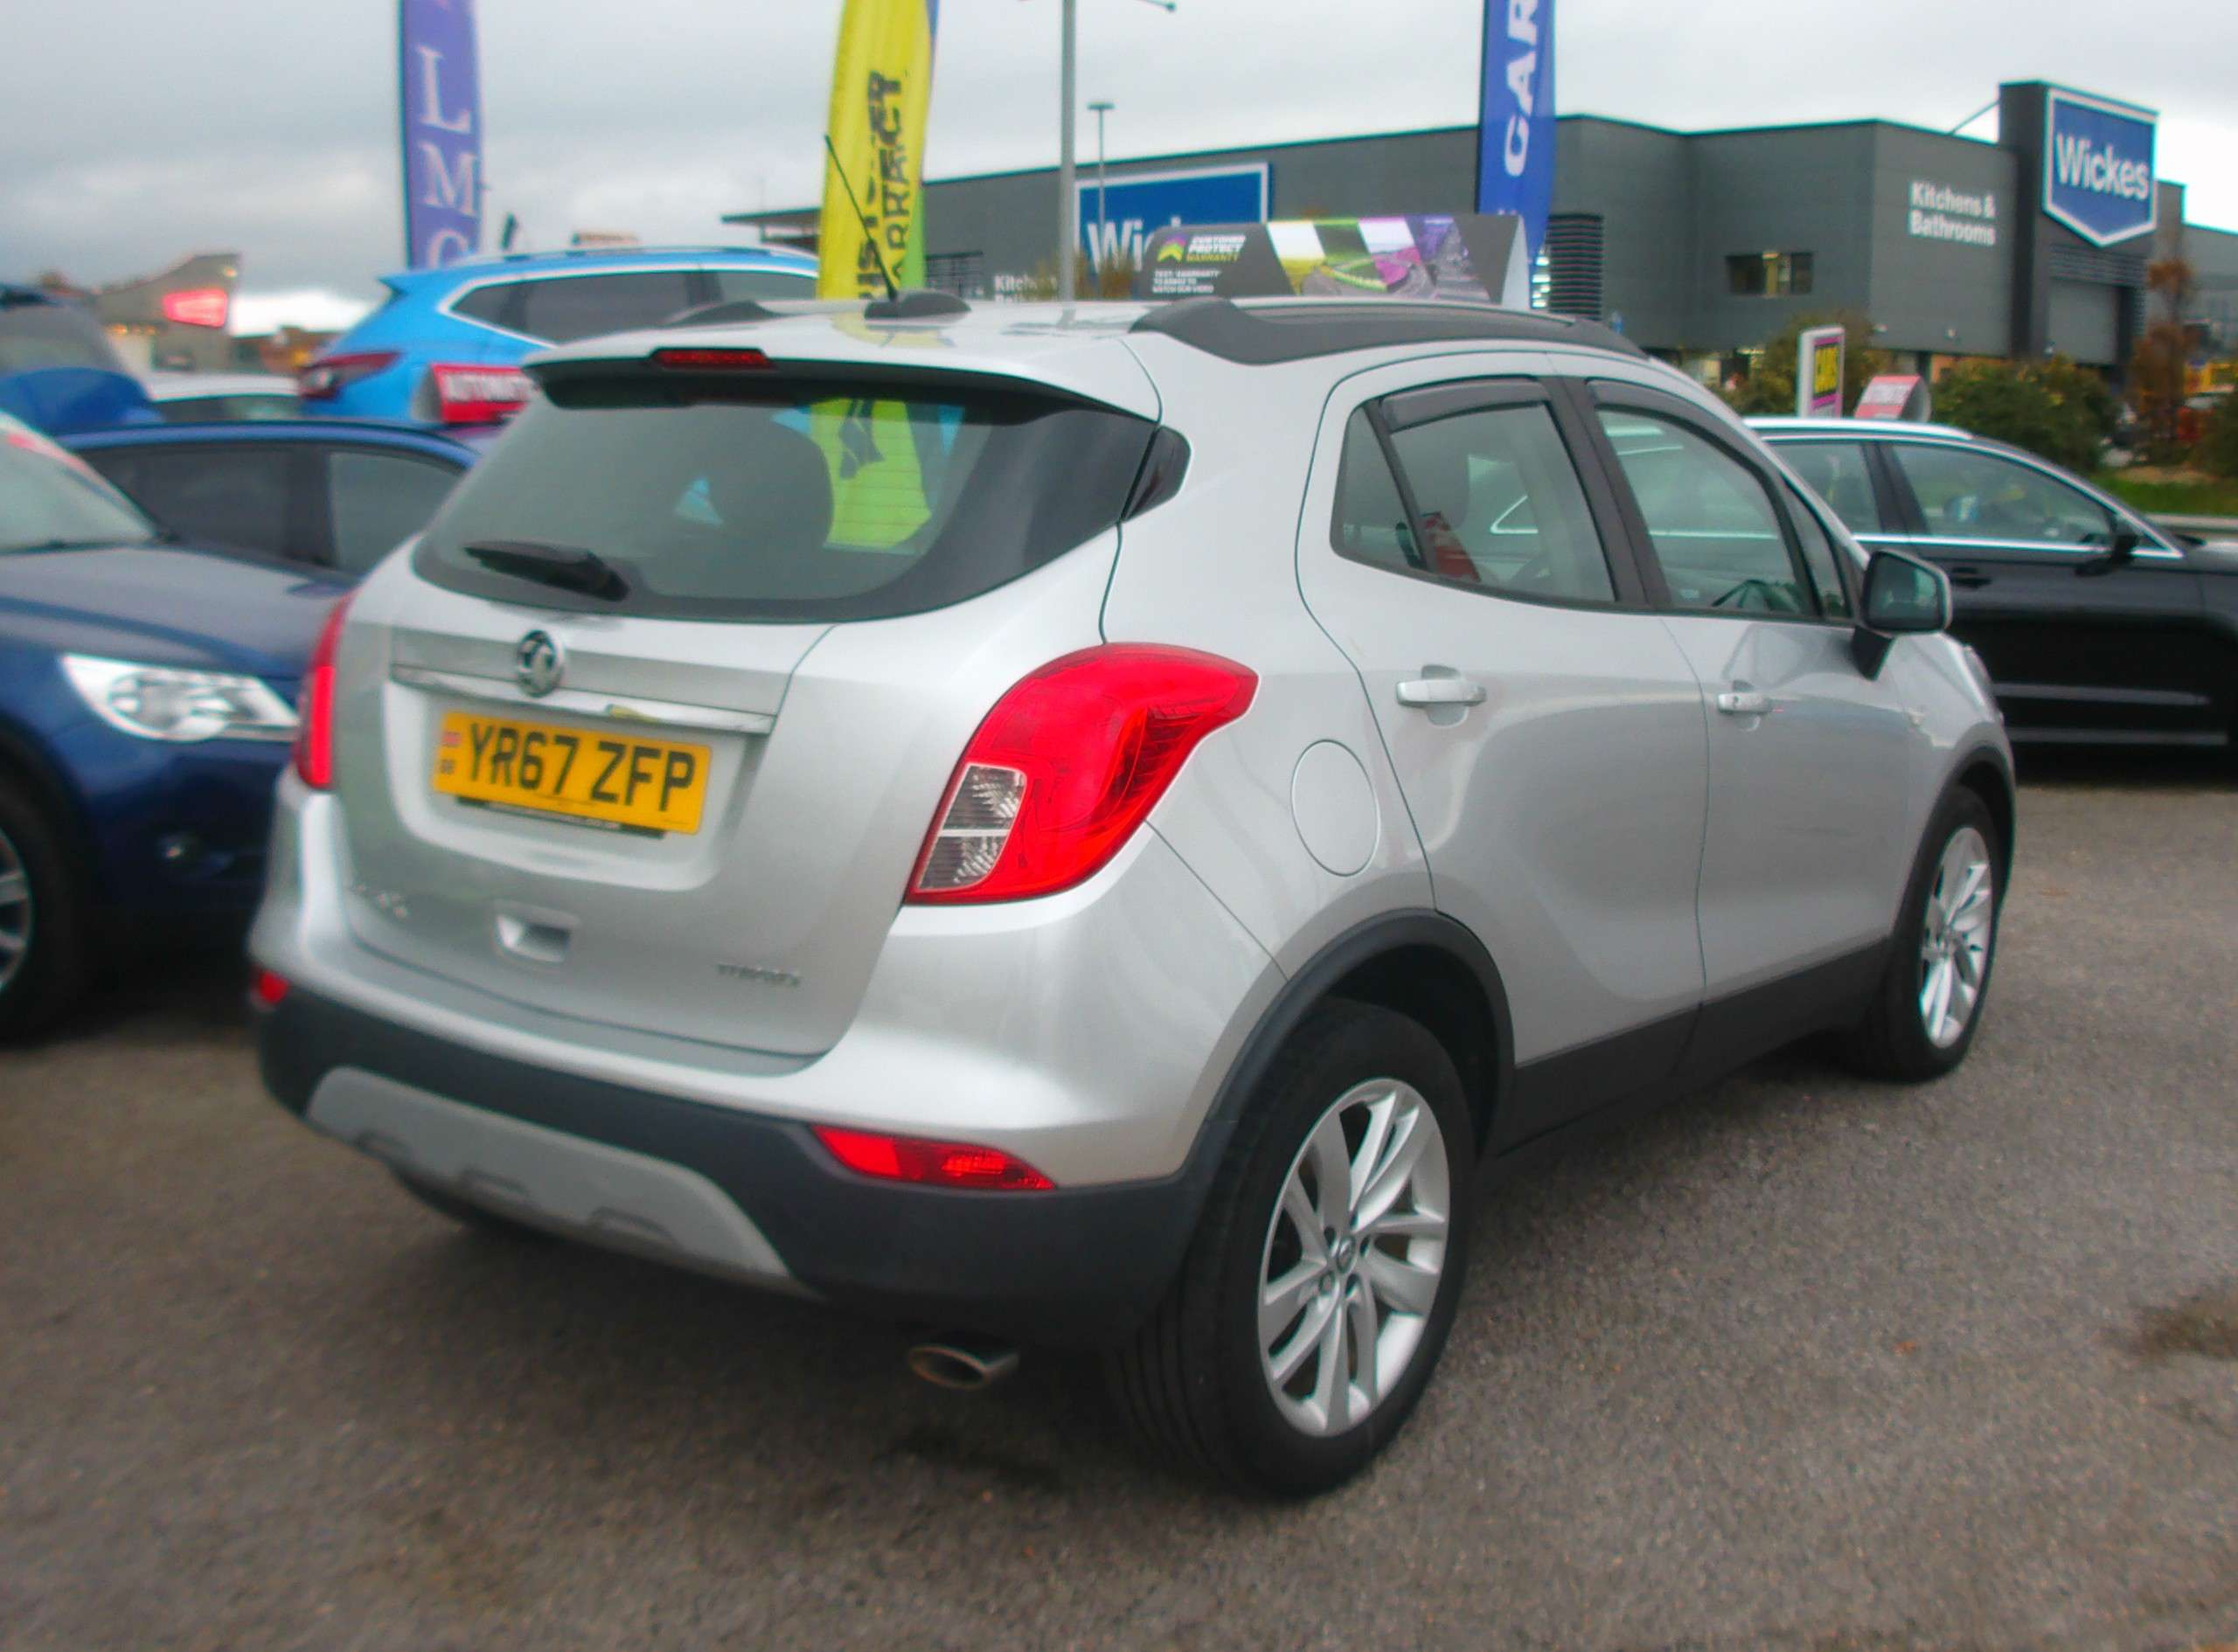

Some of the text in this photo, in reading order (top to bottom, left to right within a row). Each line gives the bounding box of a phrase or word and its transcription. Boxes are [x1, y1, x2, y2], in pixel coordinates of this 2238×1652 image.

[2056, 132, 2150, 200] Wickes
[1911, 180, 1996, 218] Kitchens &
[1909, 209, 1997, 246] Bathrooms
[469, 723, 697, 812] YR67 ZFP
